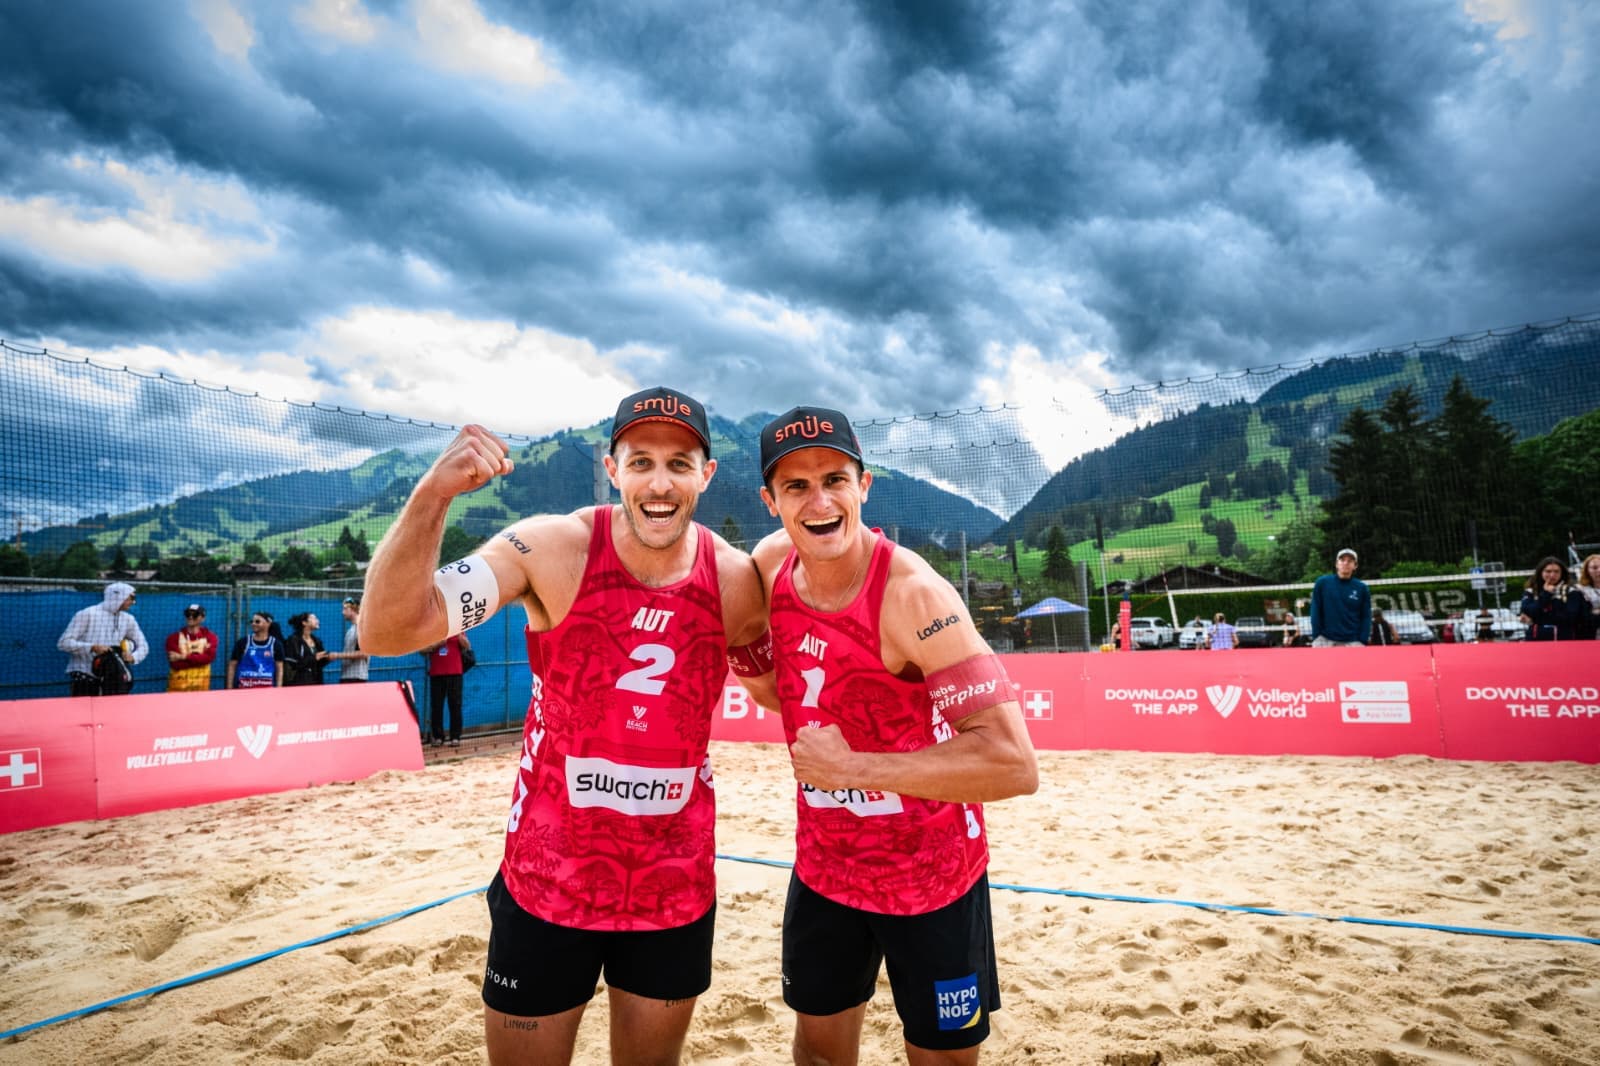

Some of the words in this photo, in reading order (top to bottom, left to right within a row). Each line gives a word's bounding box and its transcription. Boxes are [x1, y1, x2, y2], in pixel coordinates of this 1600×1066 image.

[631, 606, 675, 633] AUT
[797, 632, 828, 661] AUT
[615, 643, 676, 696] 2
[800, 666, 826, 708] 1
[1105, 688, 1198, 701] DOWNLOAD
[1465, 687, 1599, 701] DOWNLOAD
[1247, 688, 1335, 706] Volleyball
[1132, 703, 1163, 715] THE
[1167, 703, 1198, 715] APP
[1248, 703, 1307, 719] World
[1506, 703, 1551, 718] THE
[1556, 704, 1600, 719] APP
[153, 733, 208, 752] PREMIUM
[126, 750, 193, 770] VOLLEYBALL
[221, 746, 236, 760] AT
[937, 985, 978, 1005] HYPO
[939, 1002, 971, 1019] NOE
